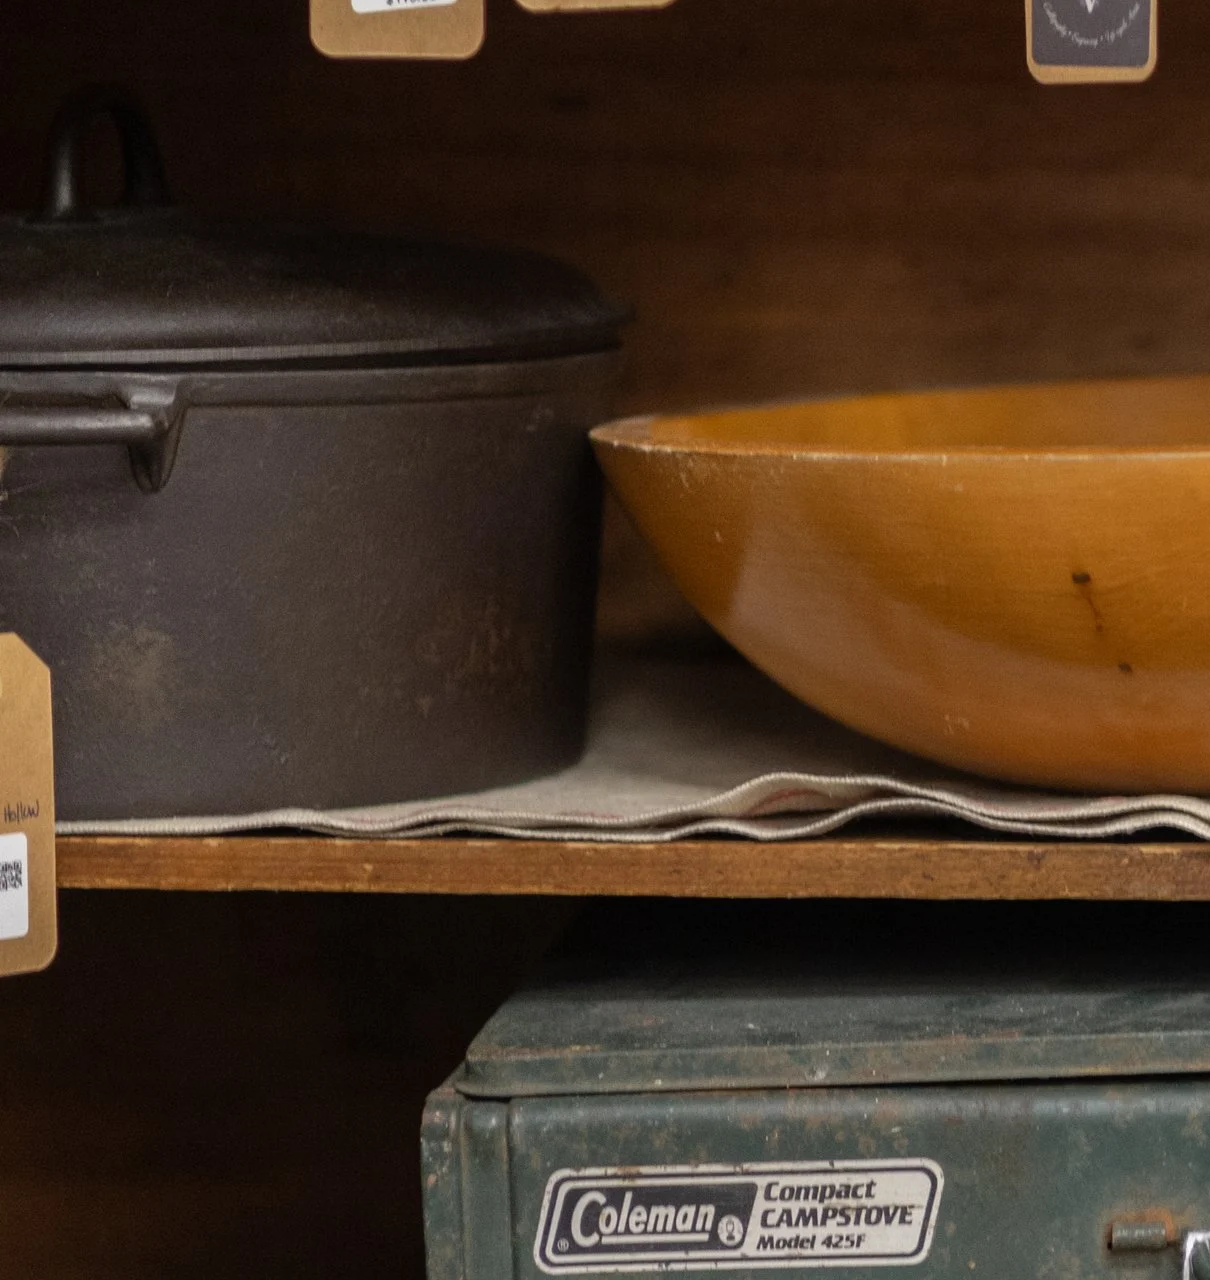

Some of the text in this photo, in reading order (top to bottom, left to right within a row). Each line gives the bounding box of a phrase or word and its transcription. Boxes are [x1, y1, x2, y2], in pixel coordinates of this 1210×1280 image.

[763, 1178, 878, 1204] Compact
[571, 1191, 715, 1248] Coleman
[760, 1205, 914, 1230] CAMPSTOVE
[756, 1233, 866, 1252] Model 425F
